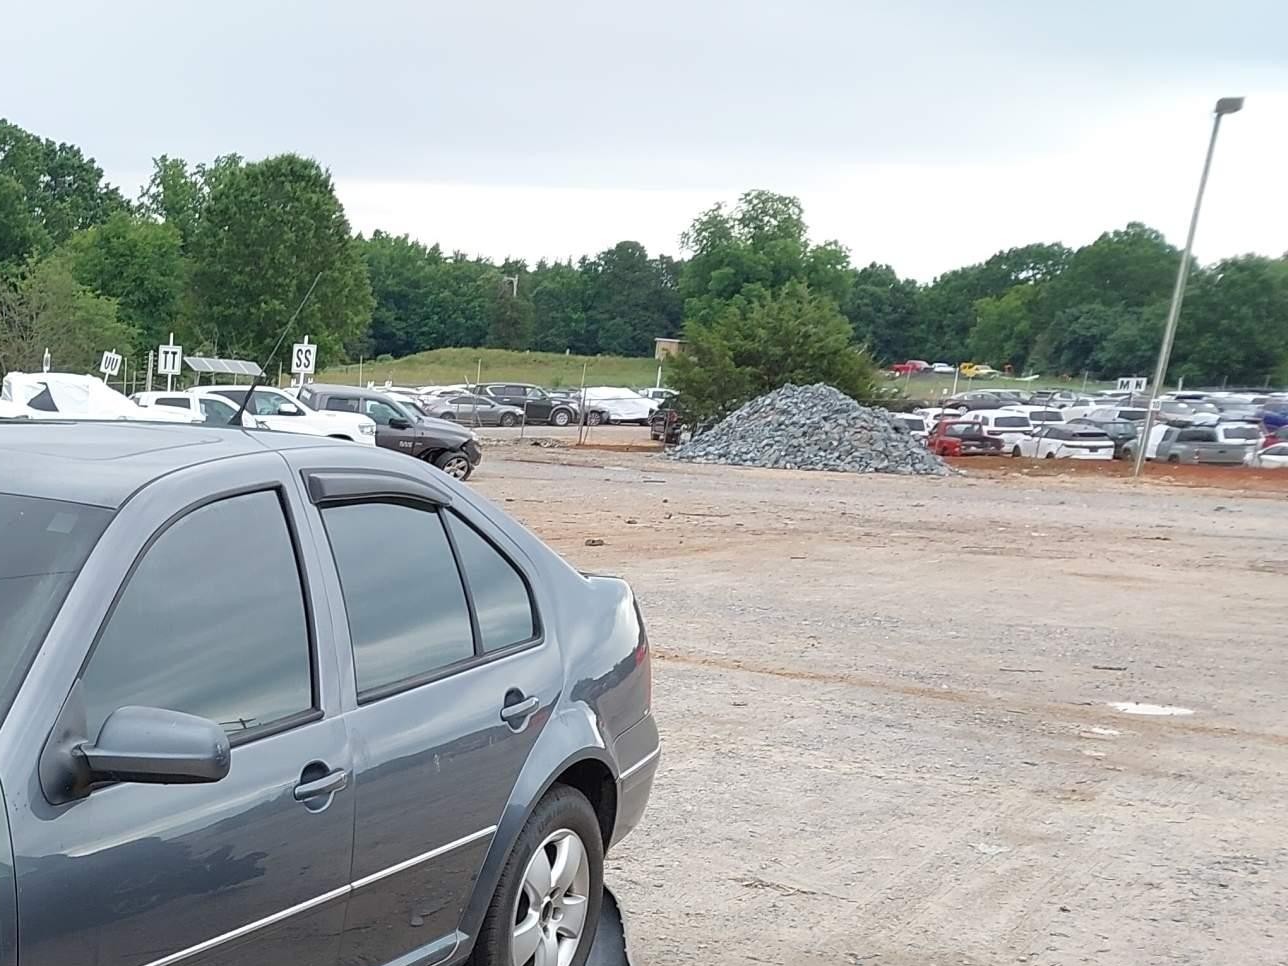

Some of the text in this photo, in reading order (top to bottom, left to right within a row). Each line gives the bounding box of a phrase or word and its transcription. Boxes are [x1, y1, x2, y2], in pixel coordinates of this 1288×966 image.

[104, 355, 119, 372] UU
[163, 350, 177, 370] TT
[295, 348, 312, 368] SS
